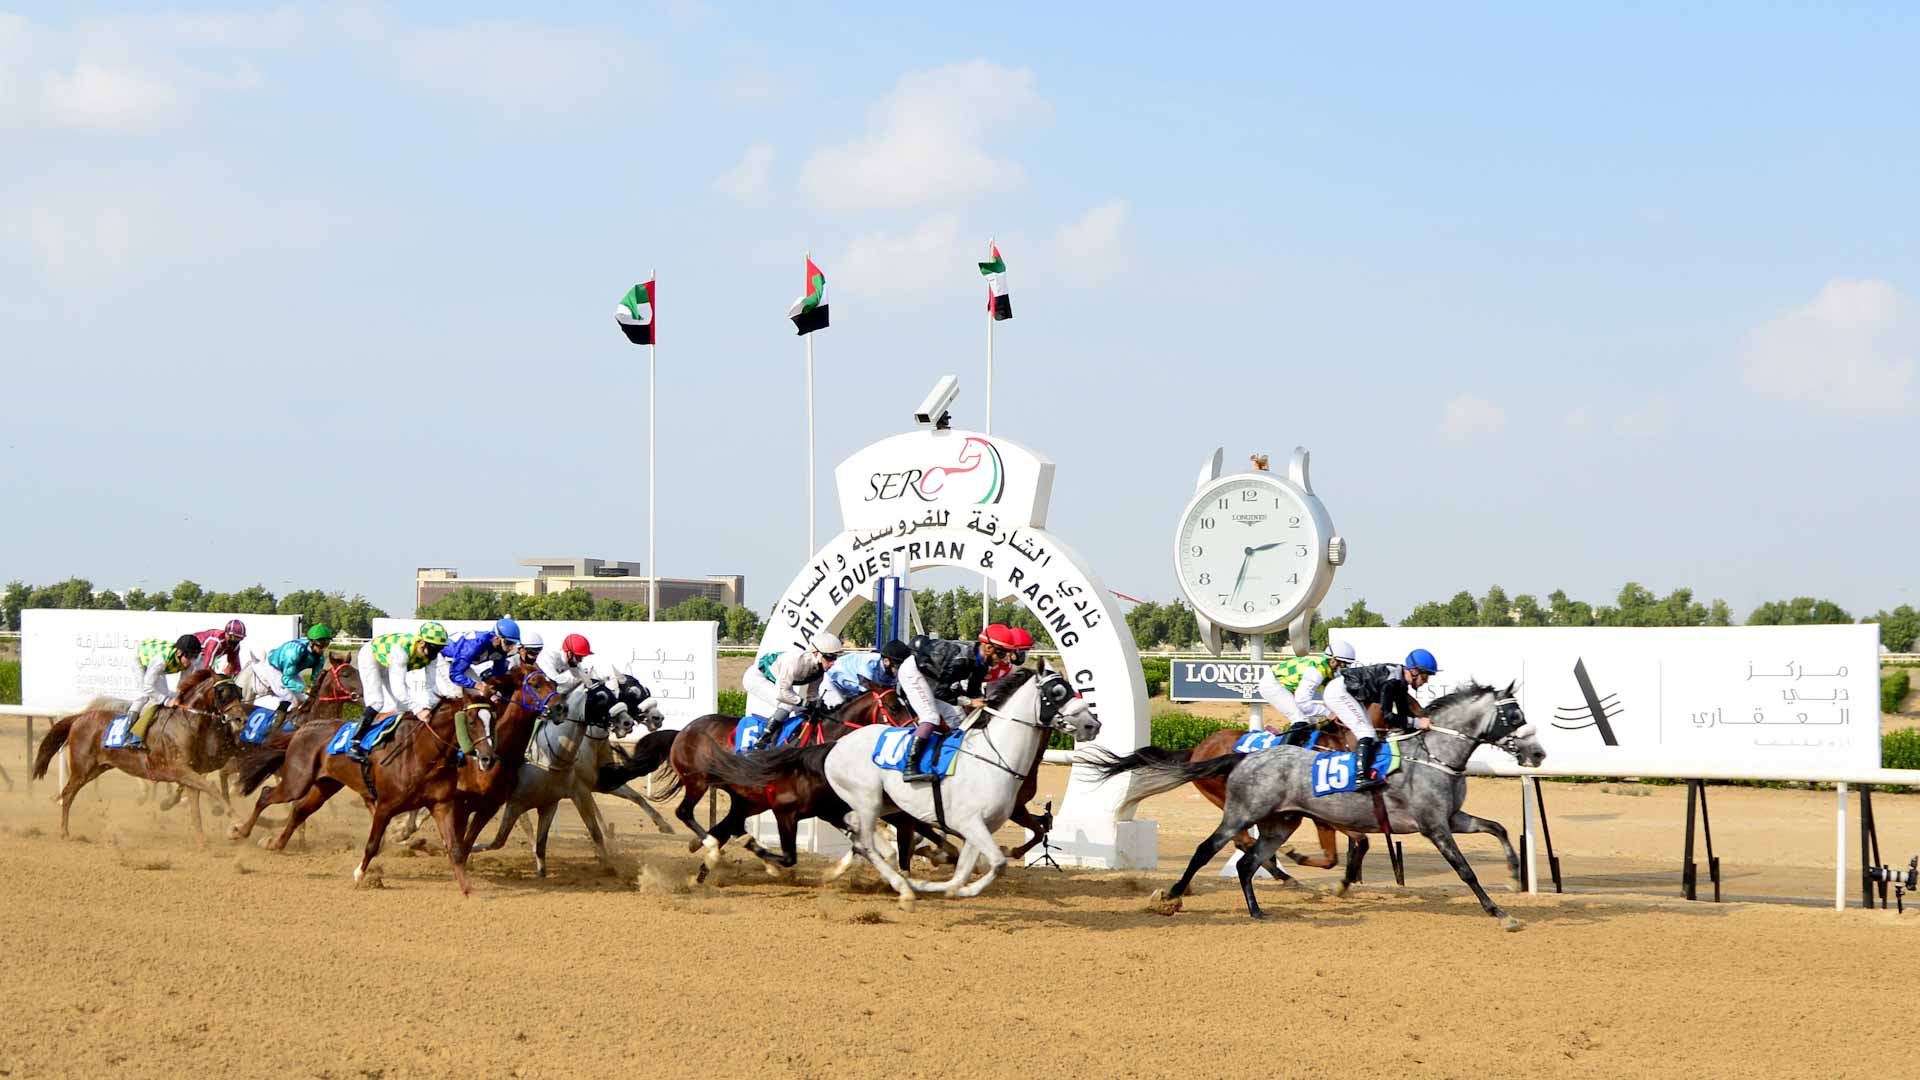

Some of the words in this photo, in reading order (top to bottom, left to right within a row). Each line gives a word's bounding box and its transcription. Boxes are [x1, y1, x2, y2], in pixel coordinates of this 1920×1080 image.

[864, 466, 944, 502] SERC
[1242, 490, 1257, 502] 12
[1219, 498, 1228, 510] 11
[1274, 498, 1279, 509] 1
[1200, 517, 1215, 529] 10
[1288, 516, 1300, 528] 2
[967, 510, 1052, 568] الشارقة
[1191, 545, 1203, 557] 9
[1295, 544, 1308, 557] 3
[1199, 572, 1211, 585] 8
[1286, 573, 1298, 584] 4
[980, 550, 993, 568] &
[1008, 567, 1079, 648] RACING
[1056, 580, 1101, 628] نادي
[1217, 594, 1229, 606] 7
[1270, 594, 1281, 606] 5
[1243, 600, 1255, 613] 6
[631, 648, 694, 664] مركز
[653, 670, 694, 684] دبي
[1186, 664, 1268, 682] LONGI
[1744, 660, 1849, 681] مركز
[1781, 688, 1849, 705] دبي
[1691, 707, 1850, 728] العقاري
[244, 712, 266, 739] 9
[1315, 753, 1350, 792] 15
